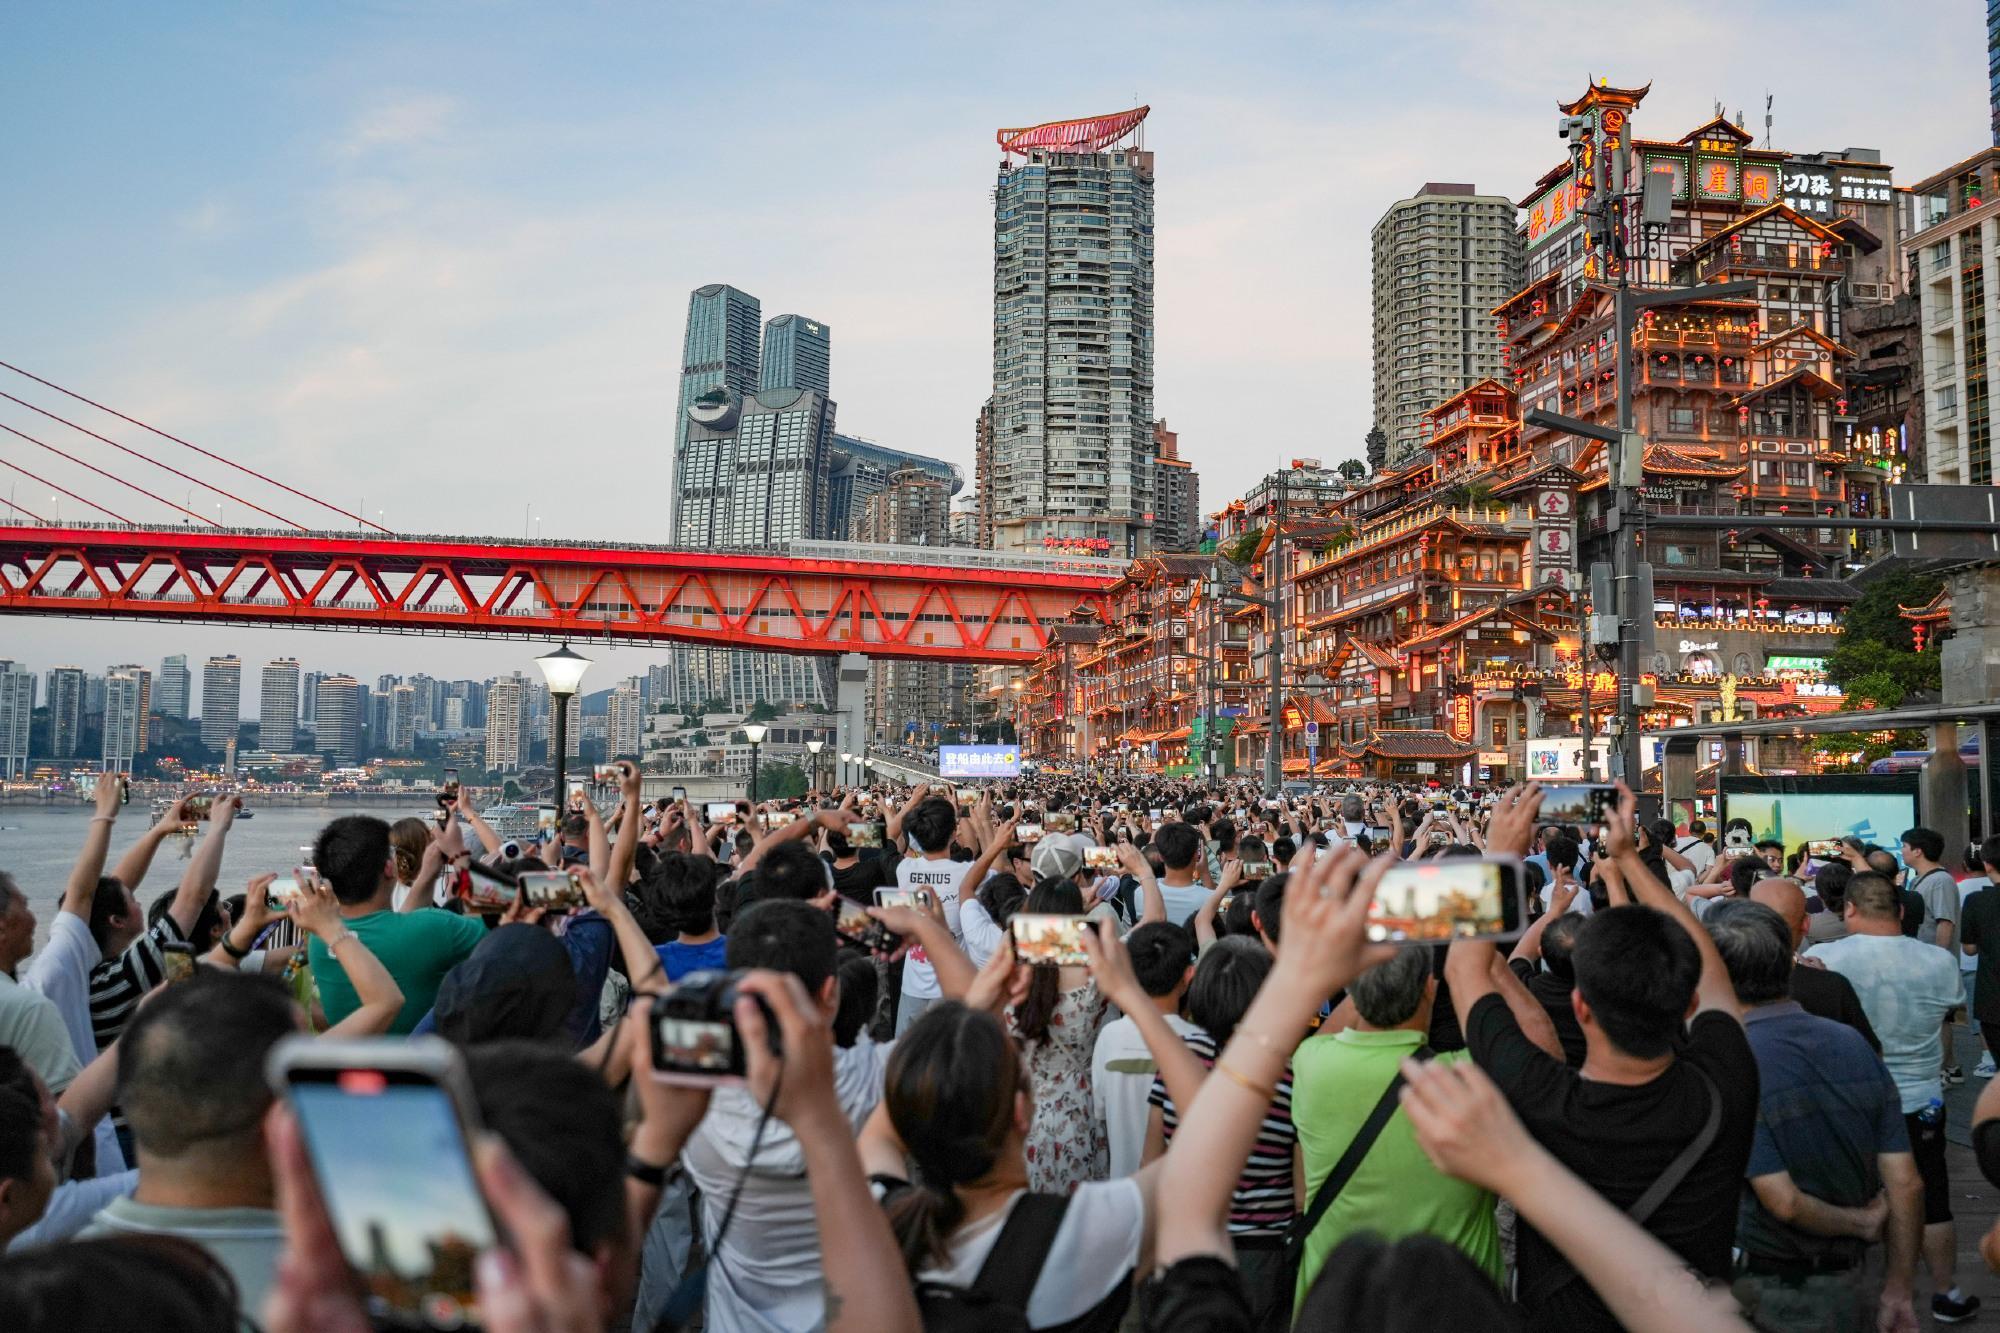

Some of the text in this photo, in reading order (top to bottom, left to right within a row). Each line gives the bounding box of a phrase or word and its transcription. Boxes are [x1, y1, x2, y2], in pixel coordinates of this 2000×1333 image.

[1841, 186, 1891, 201] 重庆火锅
[945, 752, 1004, 766] 登船由此去
[910, 872, 951, 884] GENIUS
